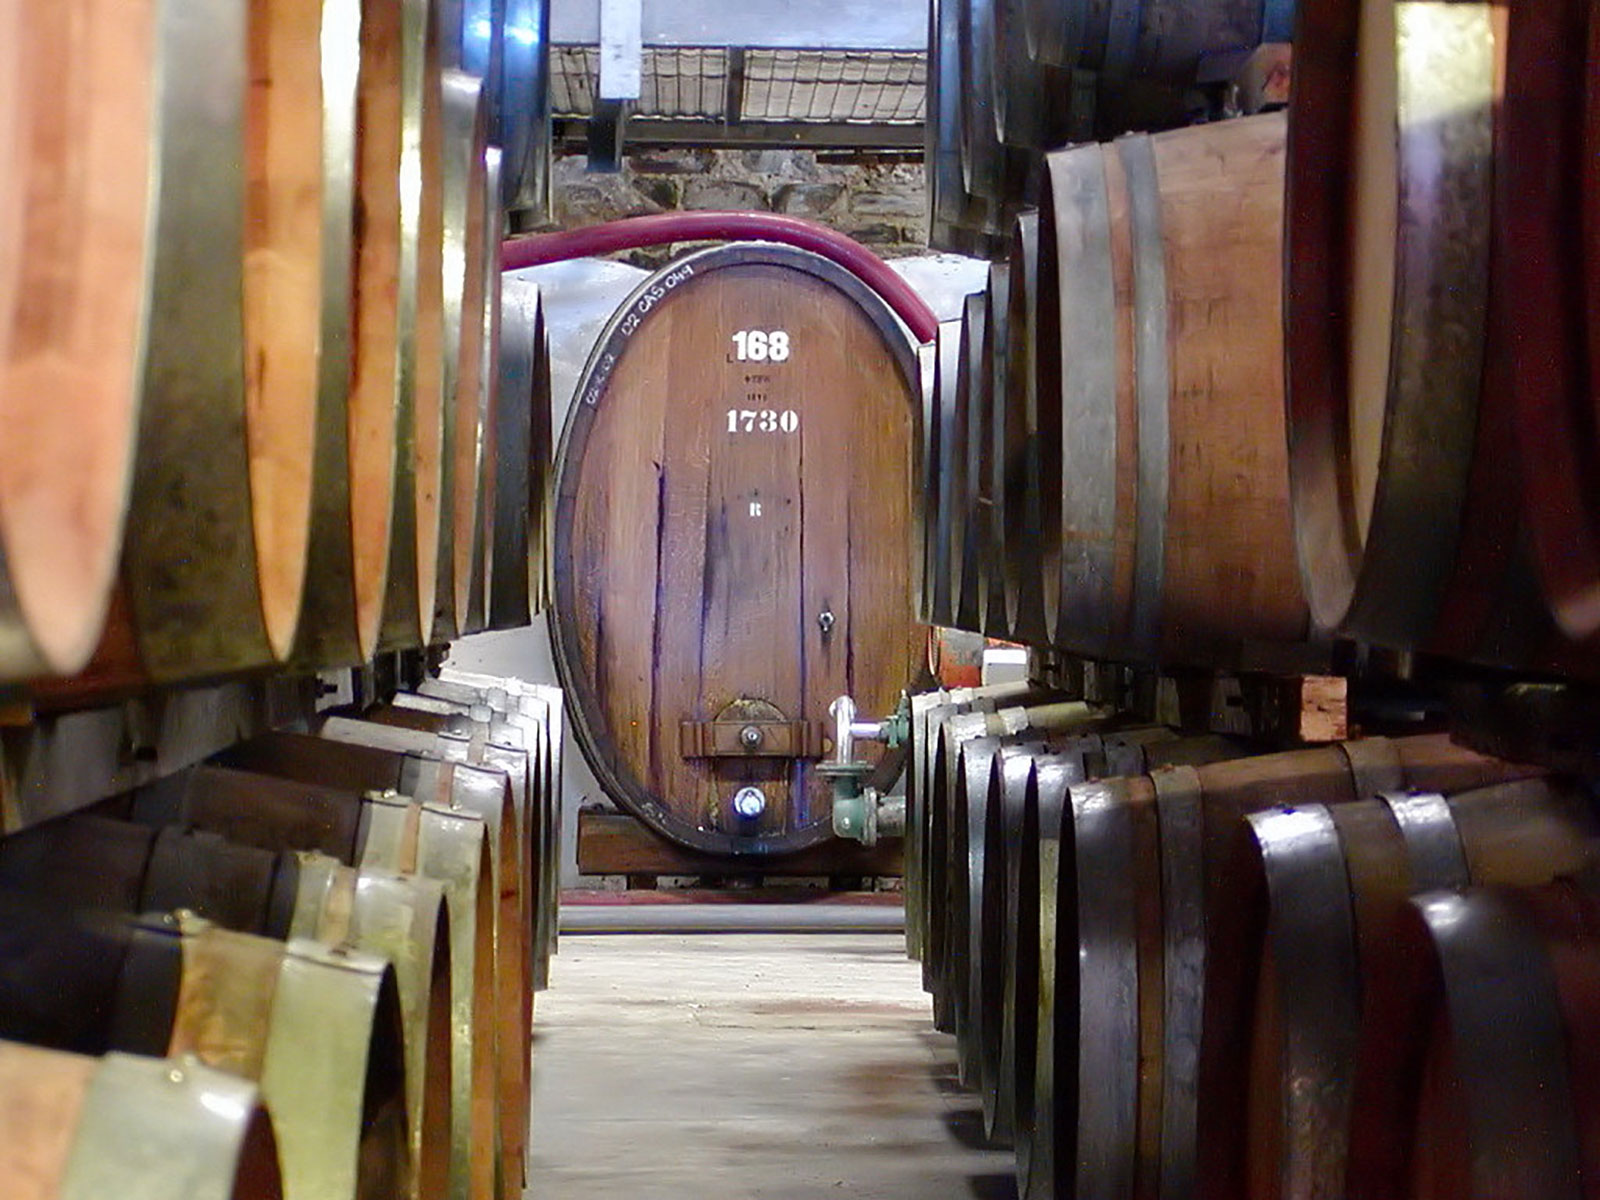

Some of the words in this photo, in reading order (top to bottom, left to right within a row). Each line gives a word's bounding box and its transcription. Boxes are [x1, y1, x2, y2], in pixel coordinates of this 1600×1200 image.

[638, 286, 667, 313] CAS
[731, 330, 790, 362] 168
[727, 410, 798, 434] 1730
[749, 502, 762, 517] R
